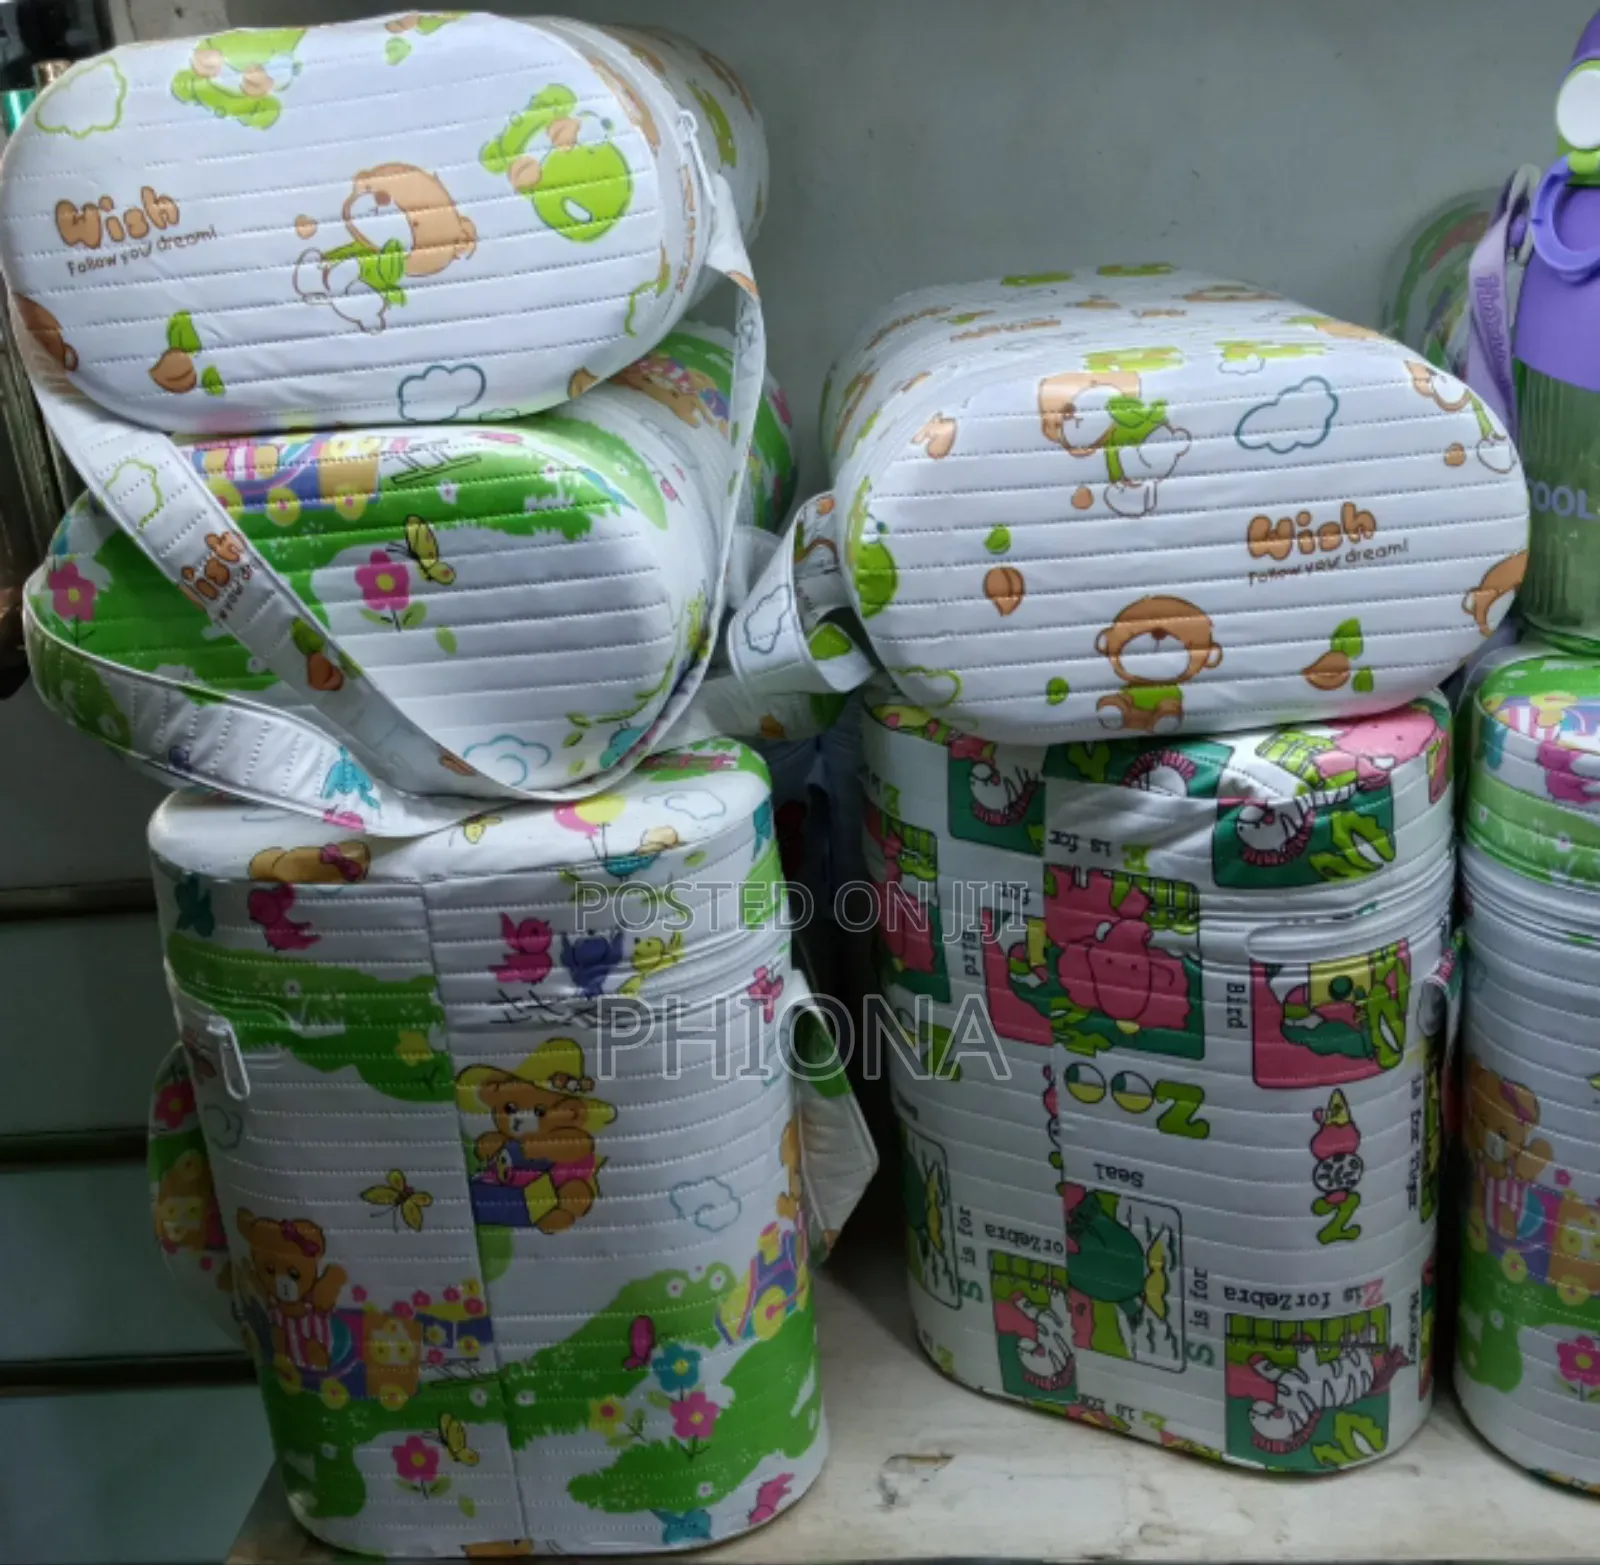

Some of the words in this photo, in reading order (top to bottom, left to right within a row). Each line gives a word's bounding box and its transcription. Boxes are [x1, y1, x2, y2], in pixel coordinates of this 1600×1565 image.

[55, 185, 180, 249] Wish
[1526, 478, 1600, 521] OOL
[1247, 501, 1377, 561] Wish
[1345, 537, 1410, 563] dream!
[179, 530, 244, 607] ish
[1226, 981, 1248, 1029] Bird
[1093, 1162, 1145, 1188] Seal
